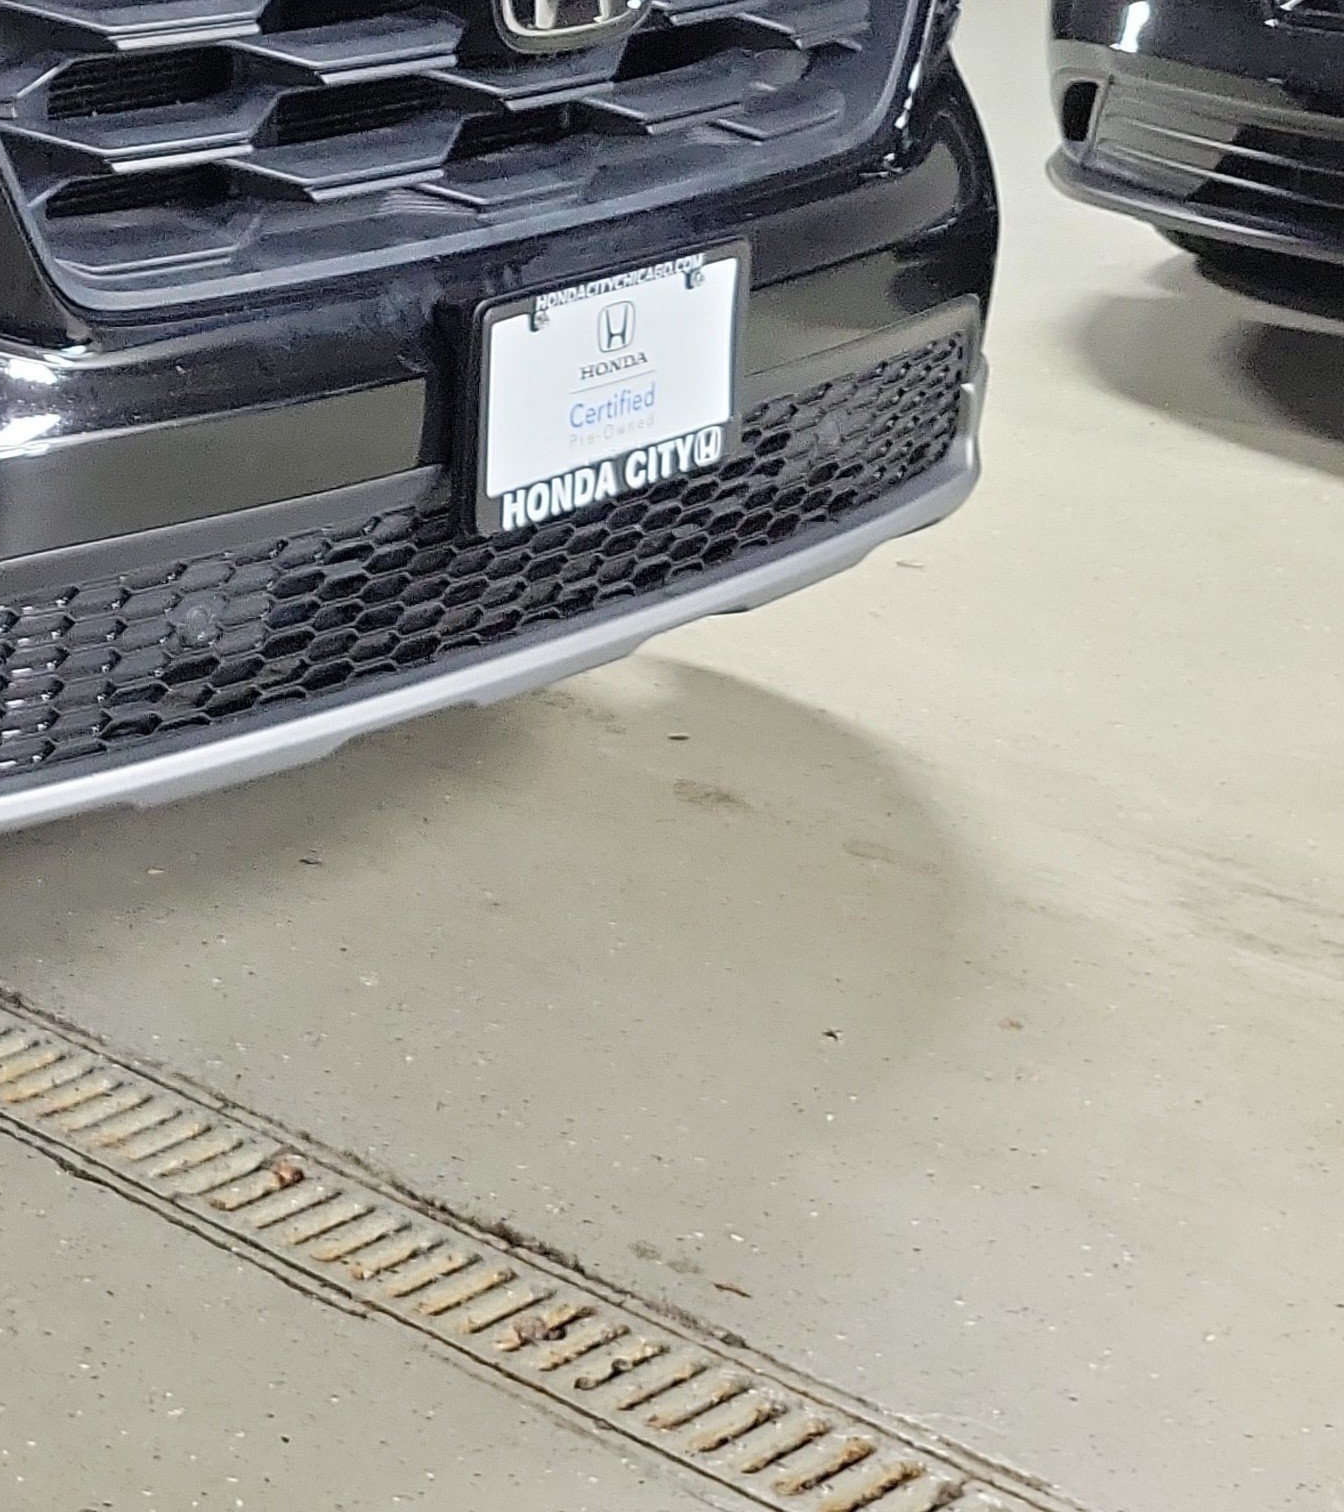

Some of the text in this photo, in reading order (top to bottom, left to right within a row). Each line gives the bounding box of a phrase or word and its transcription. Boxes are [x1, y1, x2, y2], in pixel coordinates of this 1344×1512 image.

[534, 252, 706, 312] HONDACITYCHICAGO.COM
[579, 351, 649, 380] HONDA
[569, 381, 656, 428] Certified
[501, 434, 696, 531] HONDA CITY
